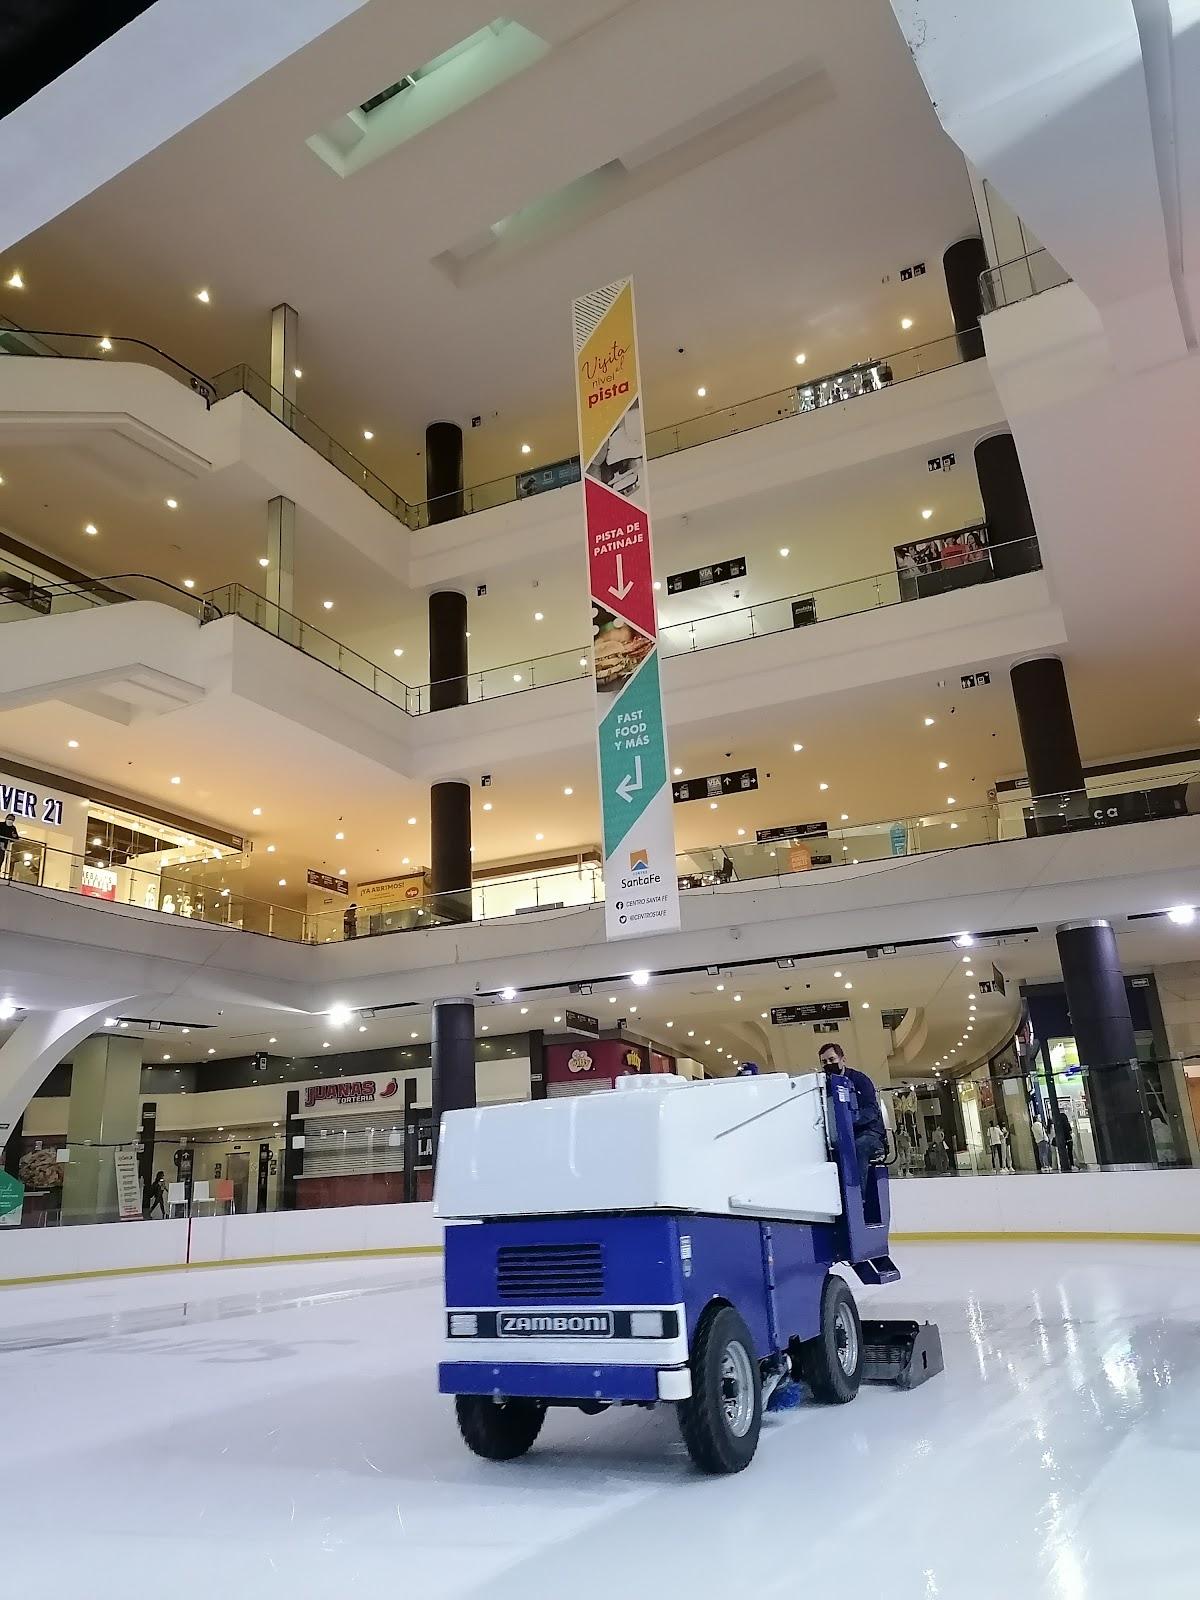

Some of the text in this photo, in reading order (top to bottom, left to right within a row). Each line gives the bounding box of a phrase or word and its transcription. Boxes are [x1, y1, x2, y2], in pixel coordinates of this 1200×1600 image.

[581, 341, 631, 379] Visita
[592, 373, 615, 388] nivel
[588, 381, 629, 408] pista
[595, 522, 640, 544] PISTA DE
[593, 533, 644, 557] PATINAJE
[617, 709, 643, 724] FAST
[615, 722, 647, 738] FOOD
[614, 734, 650, 751] Y MÁS
[42, 797, 63, 826] 21
[371, 881, 405, 893] ABRIMOS!
[621, 873, 661, 889] SantaFe
[626, 894, 668, 907] CENTRO SANTA FE
[304, 1080, 376, 1107] JUANAS
[336, 1094, 375, 1104] TORTERIA
[502, 1316, 608, 1332] ZAMBONI
